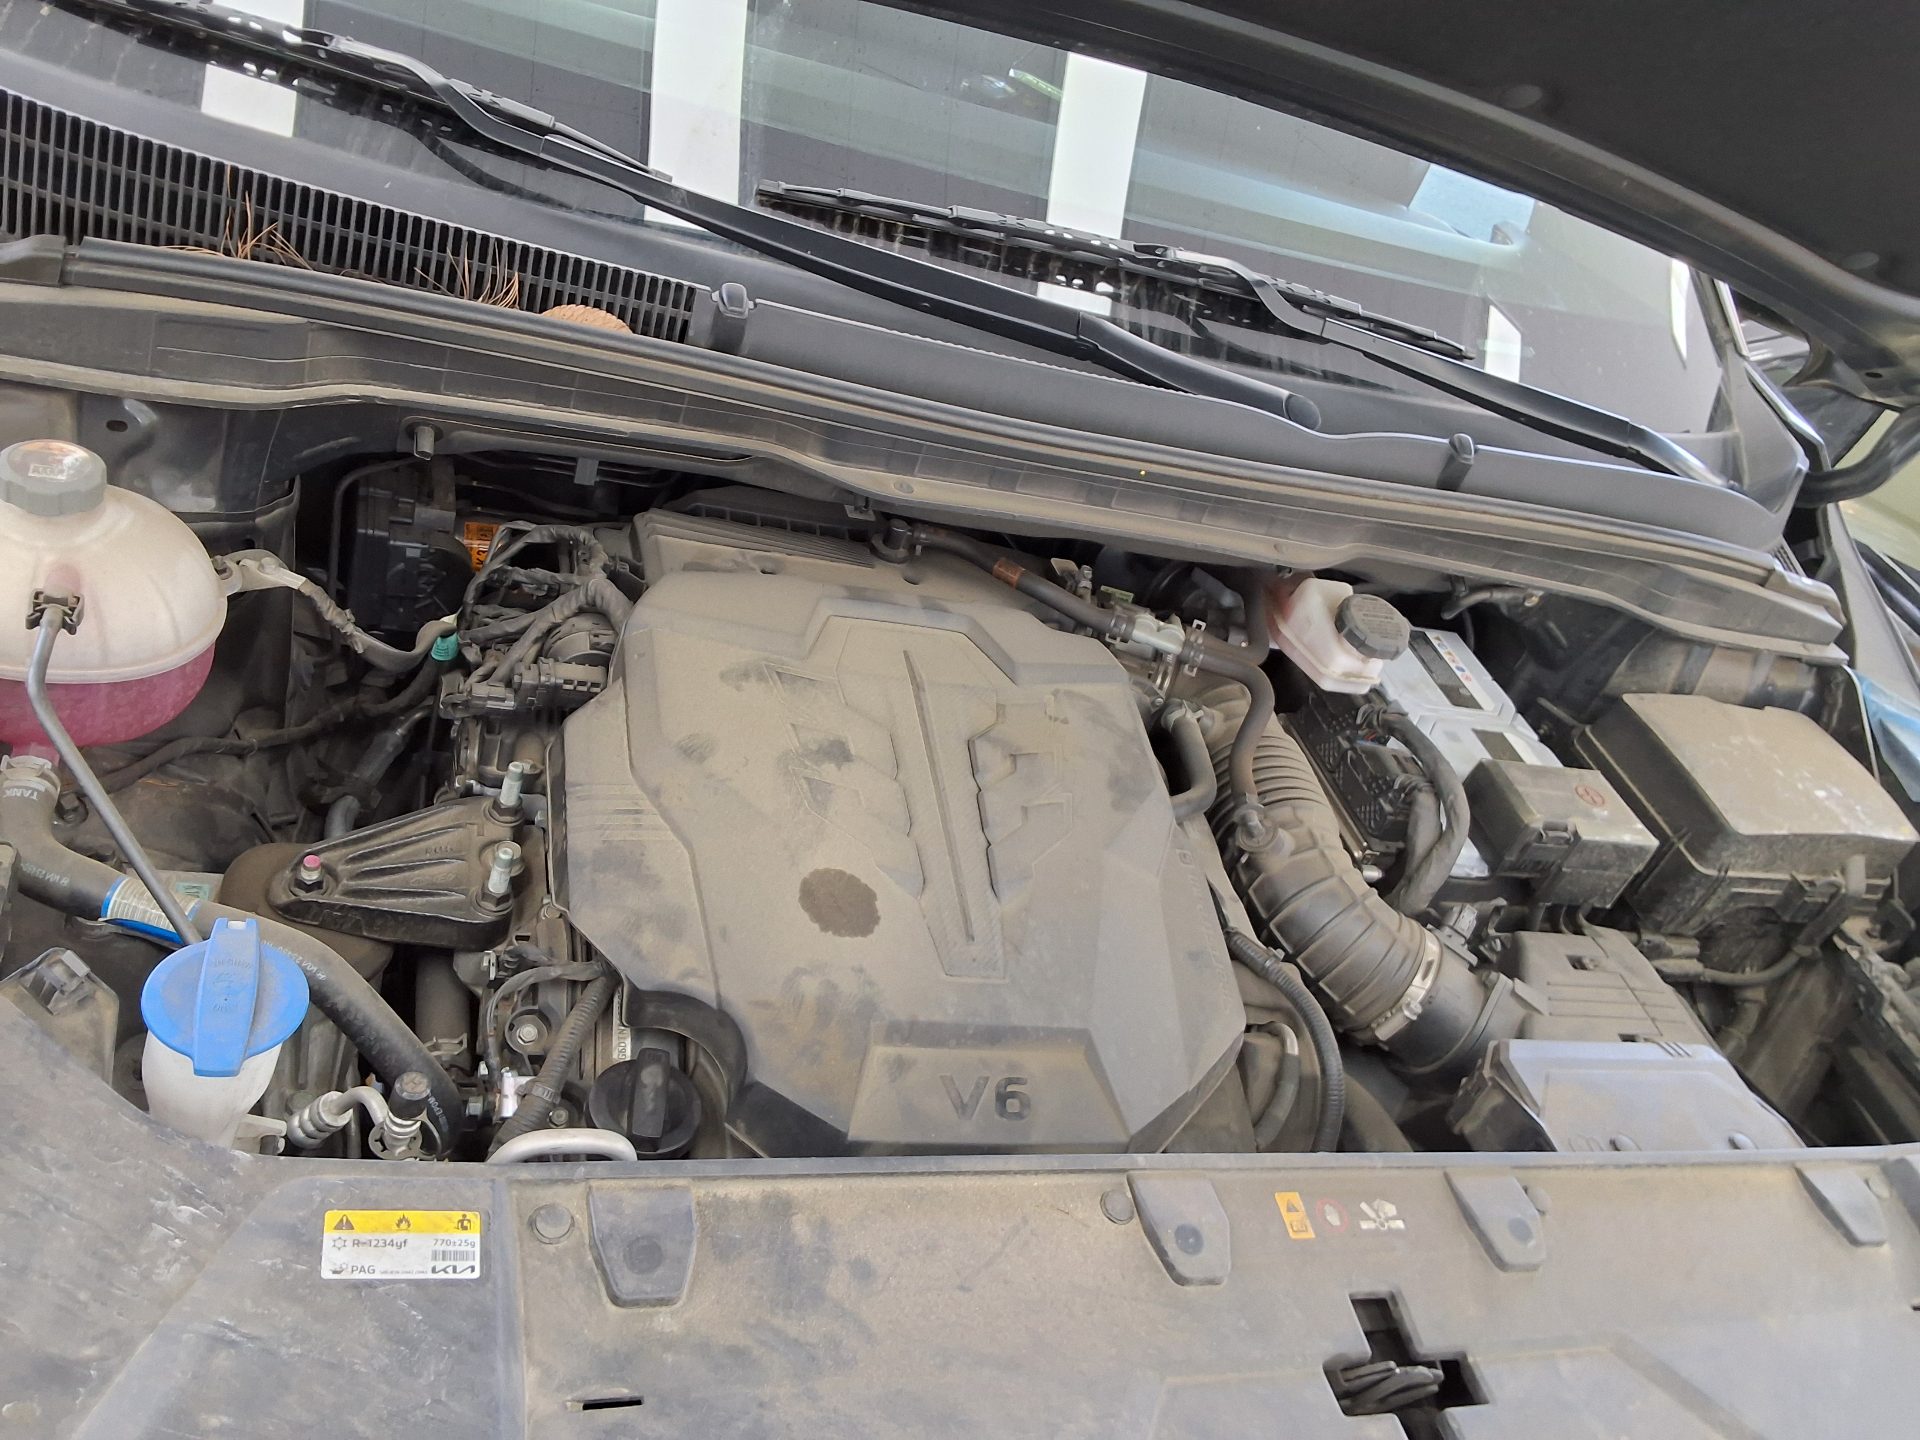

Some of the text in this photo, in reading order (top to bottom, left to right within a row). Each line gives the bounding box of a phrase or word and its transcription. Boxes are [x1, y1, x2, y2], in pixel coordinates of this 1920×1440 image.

[939, 1074, 1032, 1121] V6
[352, 1238, 476, 1249] R-1234yf 770±25g
[351, 1265, 376, 1275] PAG
[431, 1264, 476, 1274] KIA
